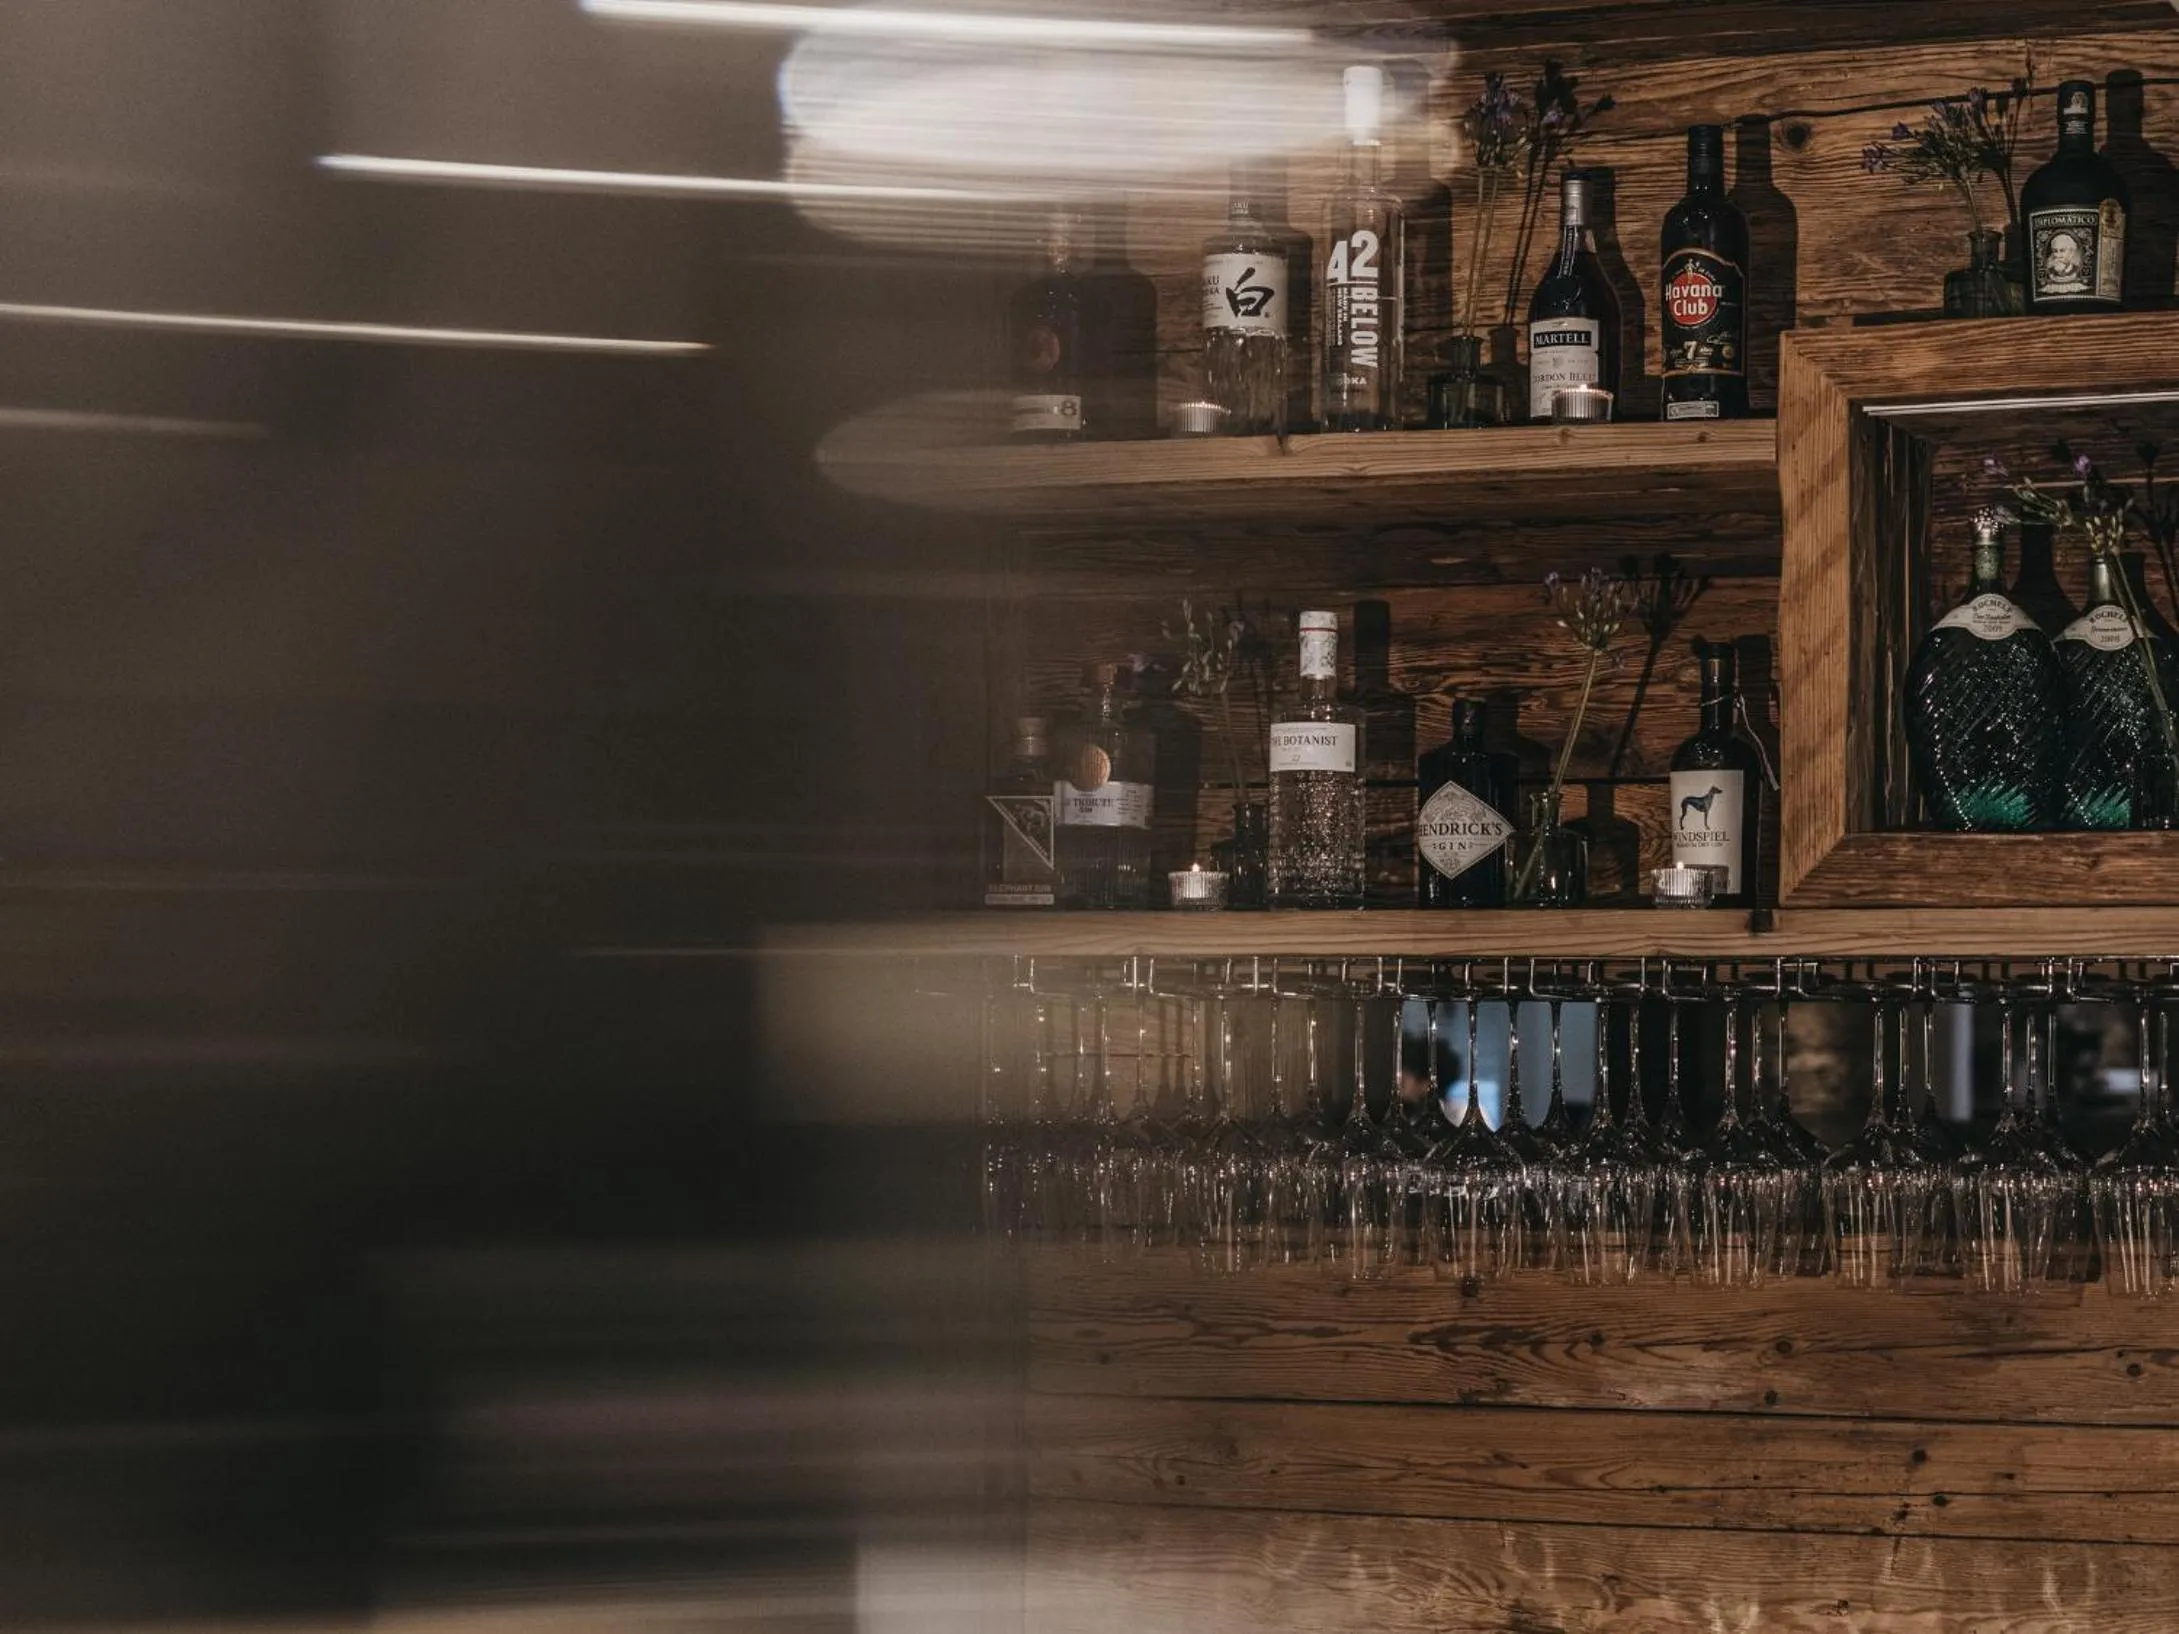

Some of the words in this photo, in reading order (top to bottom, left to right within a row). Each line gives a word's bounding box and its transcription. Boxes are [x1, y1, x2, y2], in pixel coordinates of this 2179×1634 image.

[1327, 230, 1378, 285] 42
[1225, 267, 1275, 317] 白
[1665, 283, 1722, 301] Havana
[1674, 299, 1709, 316] Club
[1350, 287, 1379, 368] BELOW
[1535, 332, 1589, 344] MARTELL
[1683, 341, 1697, 360] 7
[1283, 736, 1338, 746] BOTANIST
[1438, 842, 1467, 850] GIN
